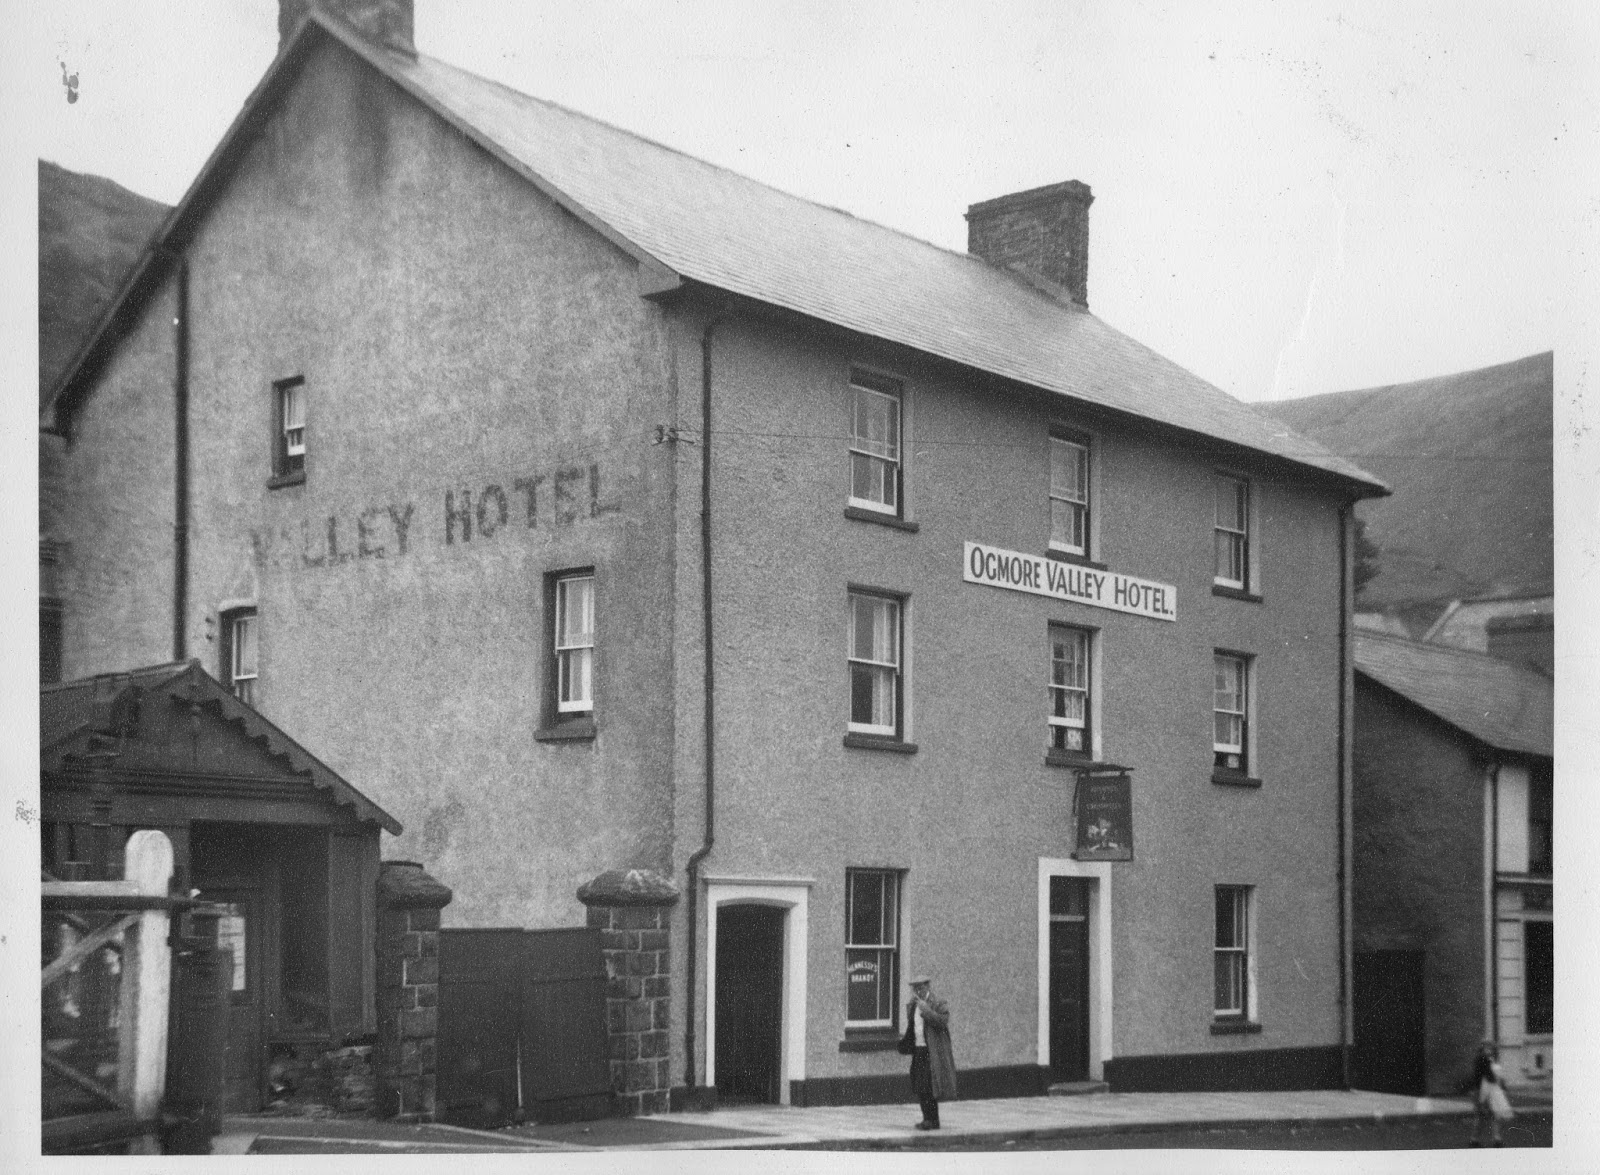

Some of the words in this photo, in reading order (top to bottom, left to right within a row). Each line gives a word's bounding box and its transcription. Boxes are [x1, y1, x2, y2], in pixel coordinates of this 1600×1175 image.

[445, 463, 621, 546] HOTEL
[969, 546, 1041, 589] OGMORE
[1046, 561, 1105, 601] VALLEY
[1114, 576, 1174, 616] HOTEL.
[851, 974, 875, 983] BRANDY
